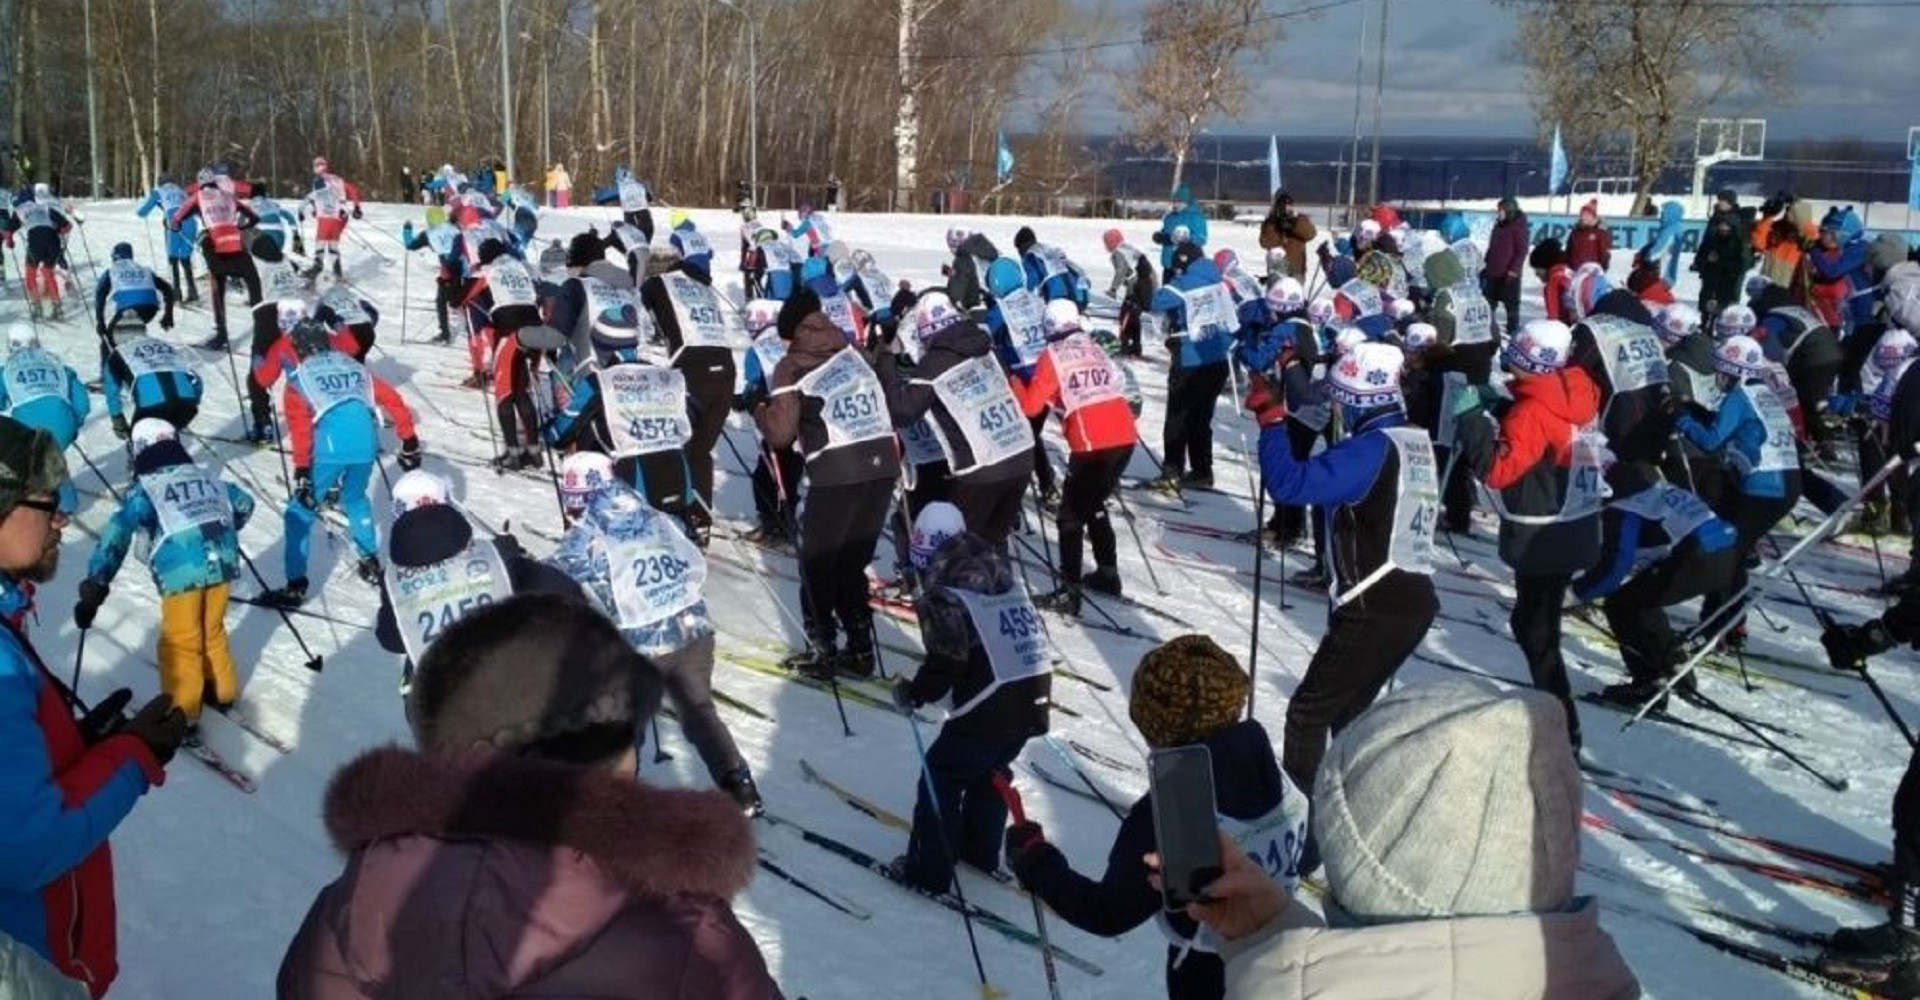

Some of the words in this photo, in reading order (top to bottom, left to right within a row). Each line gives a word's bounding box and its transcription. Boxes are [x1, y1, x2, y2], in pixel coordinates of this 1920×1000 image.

[832, 389, 878, 420] 4531
[980, 398, 1019, 430] 4517
[164, 479, 219, 502] 4771
